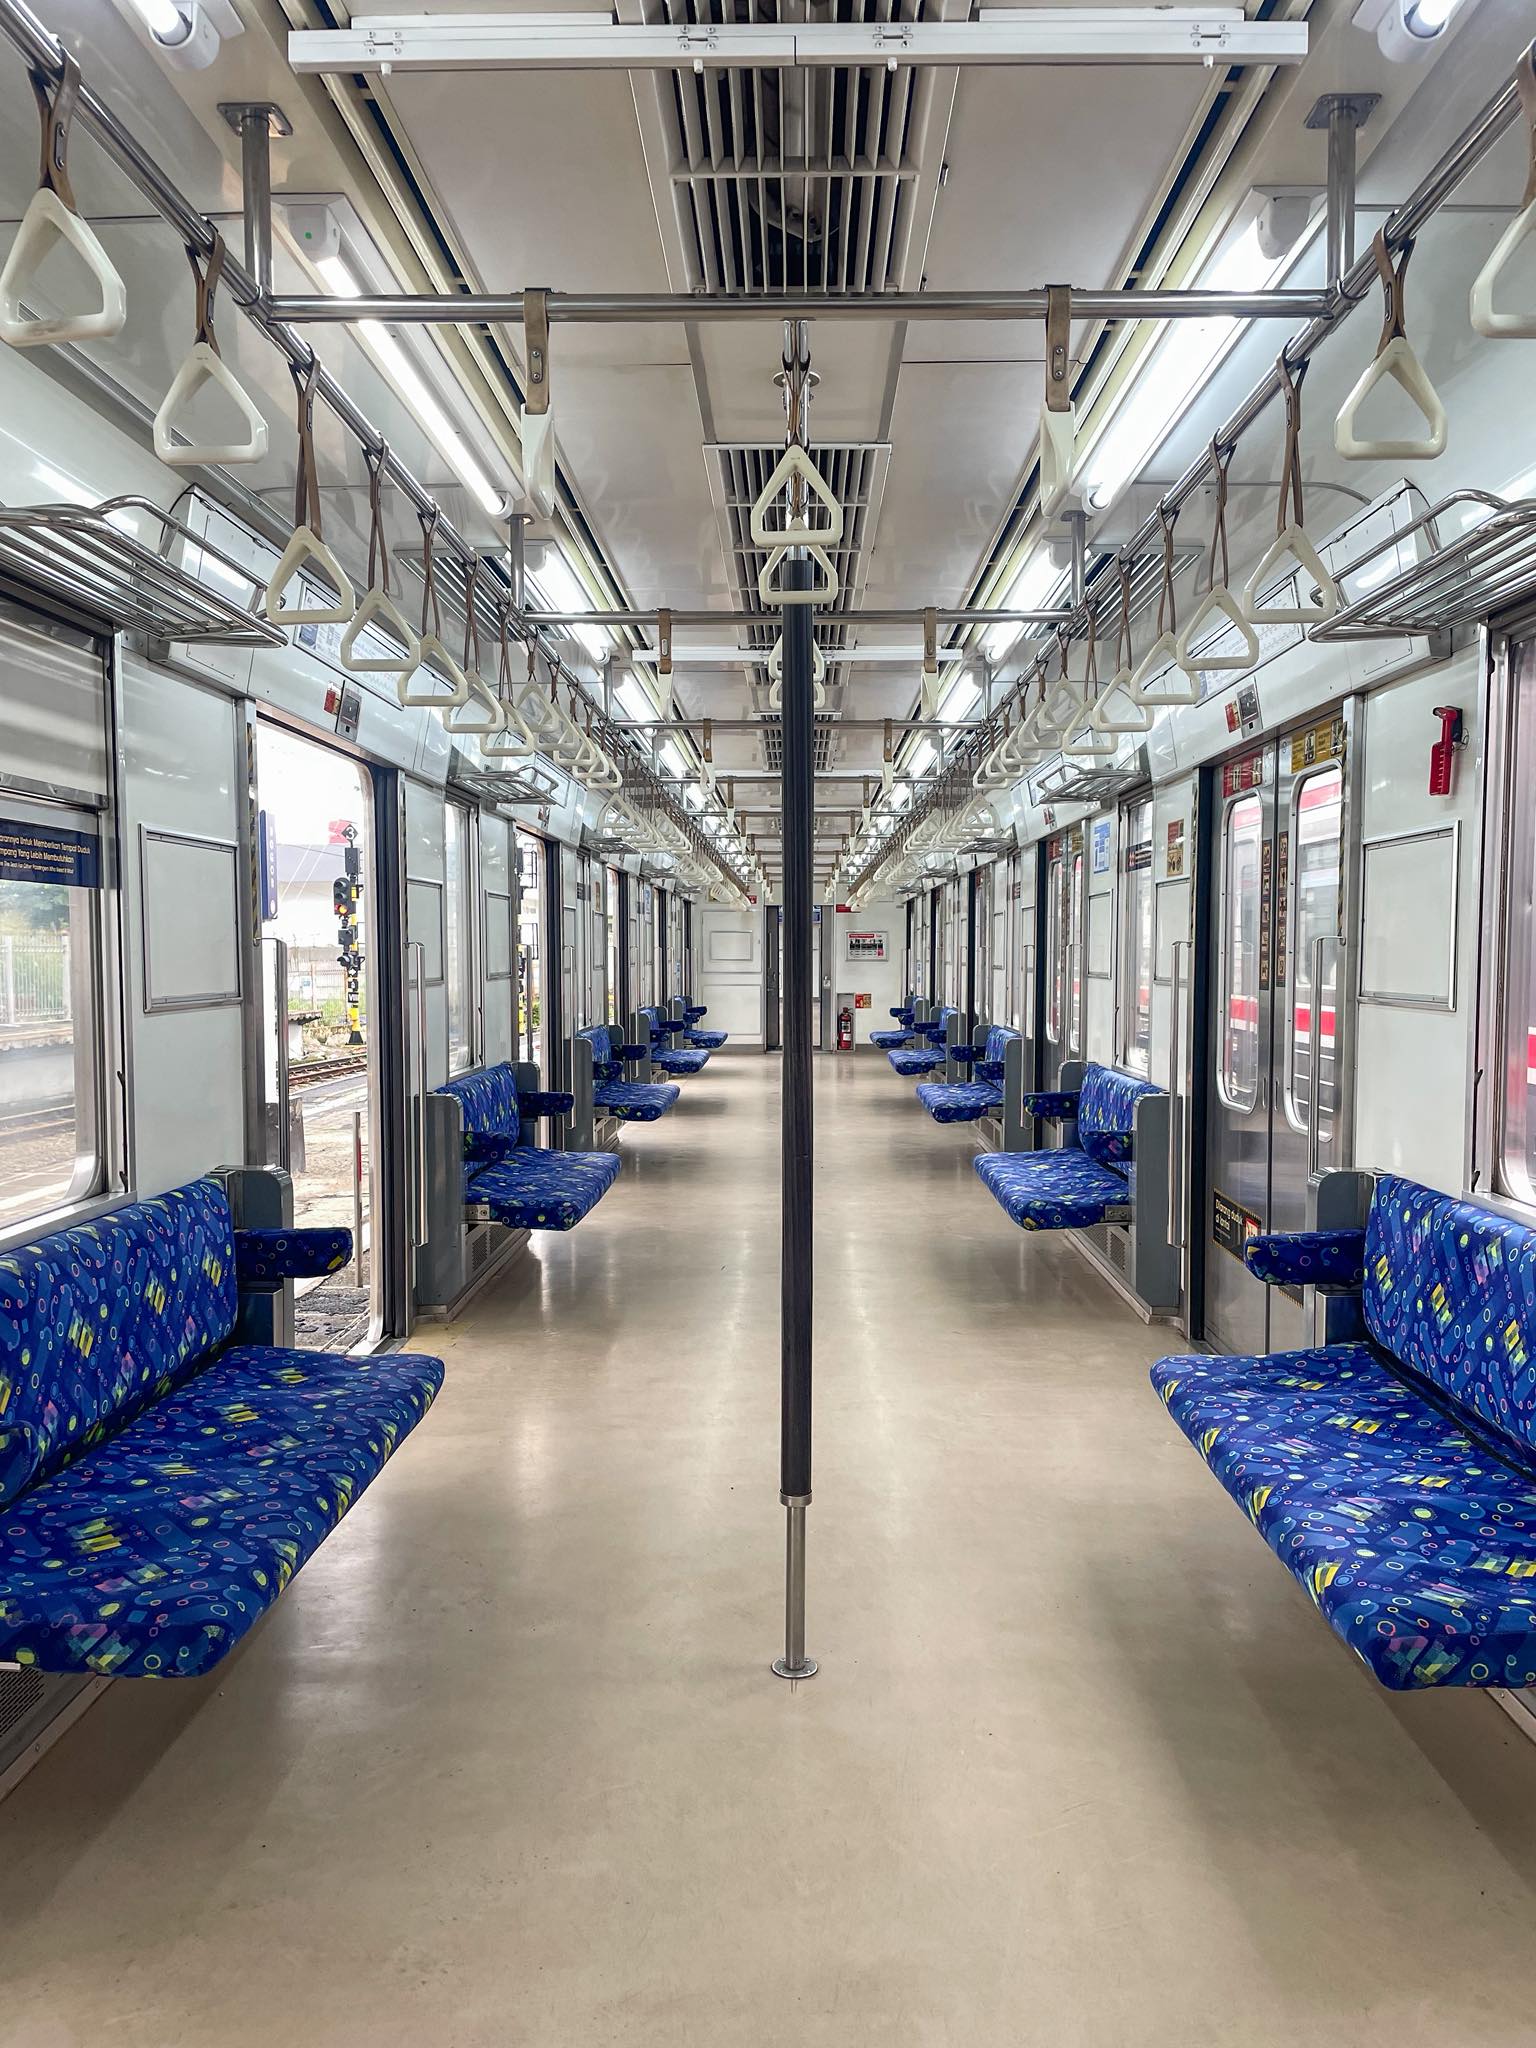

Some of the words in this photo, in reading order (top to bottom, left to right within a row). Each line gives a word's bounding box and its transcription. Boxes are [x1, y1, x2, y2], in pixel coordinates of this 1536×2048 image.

[345, 826, 355, 840] 3
[20, 836, 33, 846] Untuk
[33, 838, 60, 849] Memberikan
[61, 843, 77, 853] Tempat
[78, 845, 91, 854] Duduk
[18, 848, 30, 860] Yang
[31, 850, 43, 859] Lebih
[43, 852, 74, 863] Membutuhkan
[1215, 1199, 1230, 1220] Dilarang
